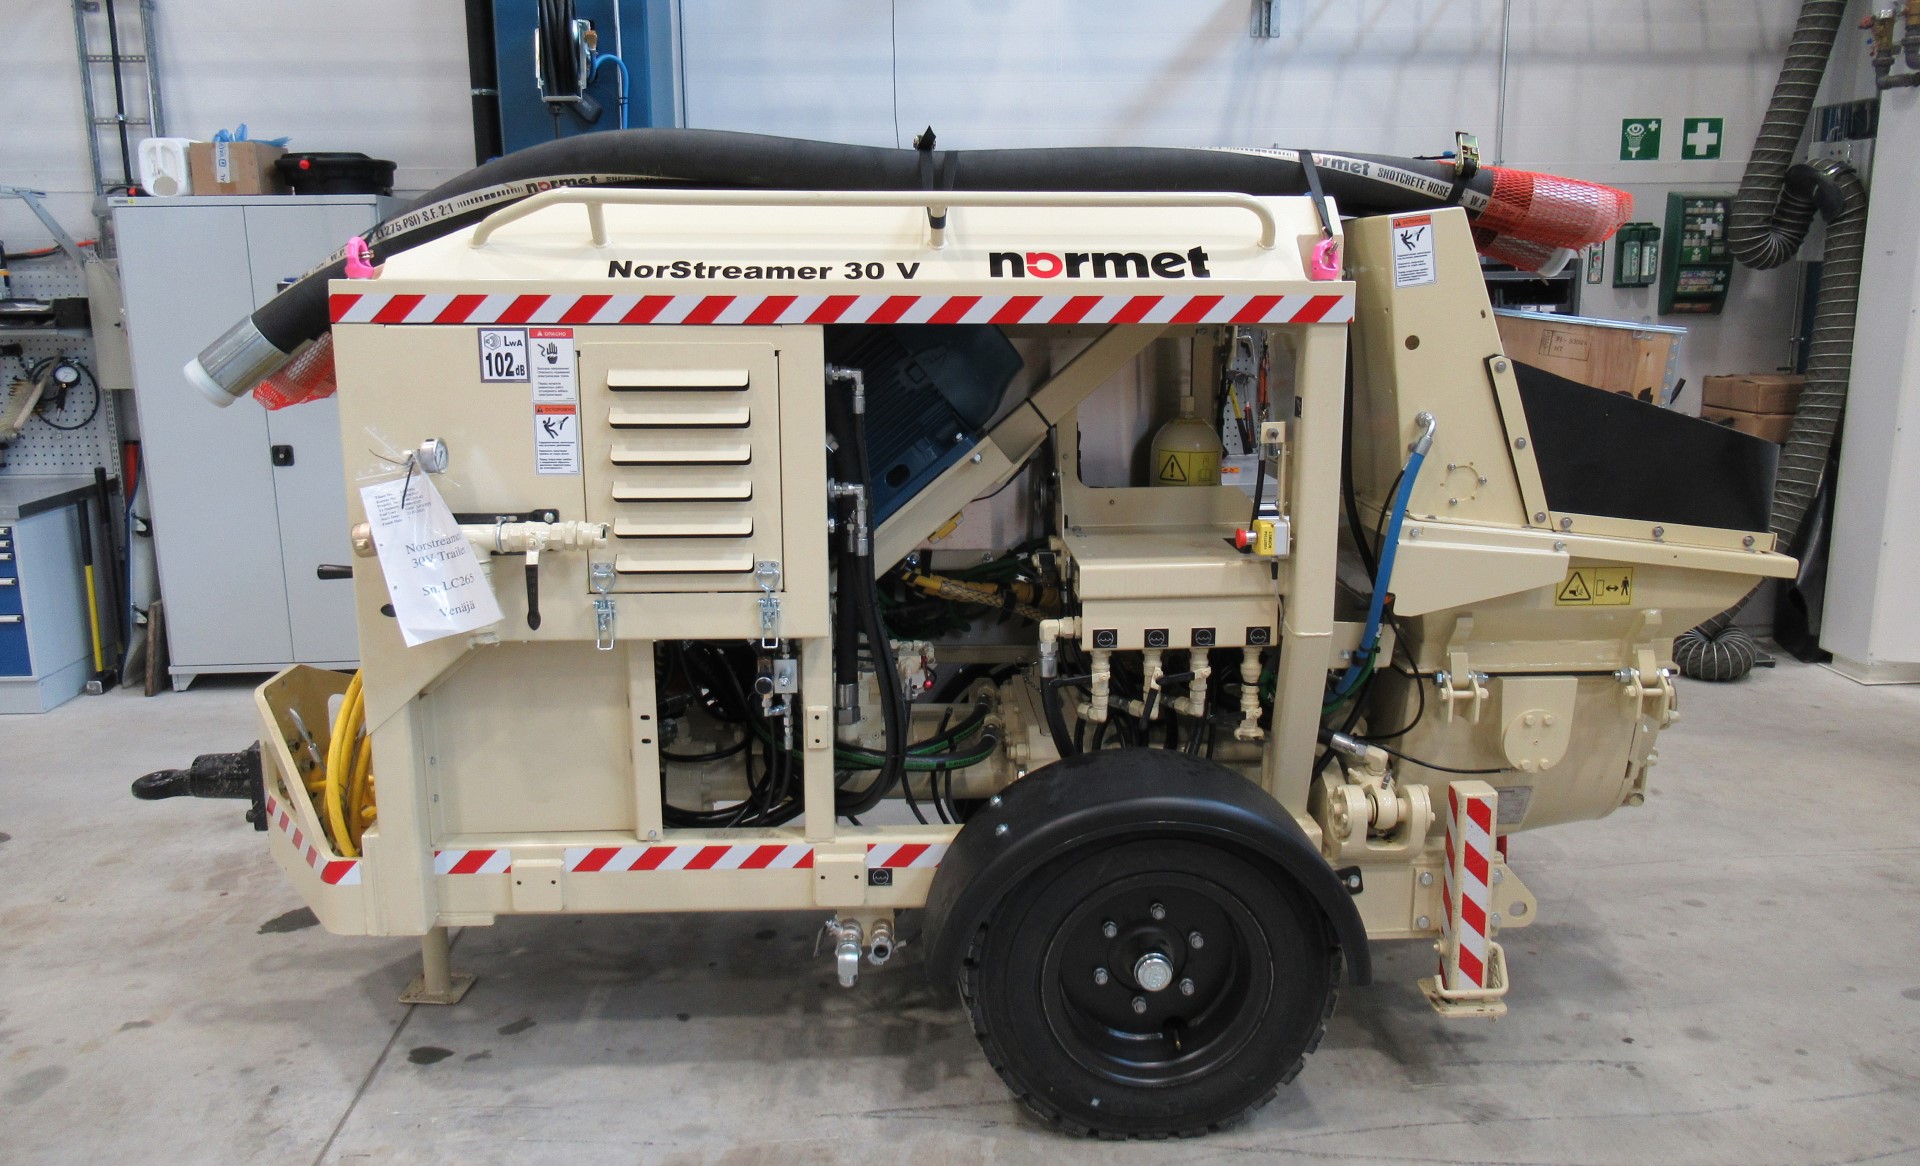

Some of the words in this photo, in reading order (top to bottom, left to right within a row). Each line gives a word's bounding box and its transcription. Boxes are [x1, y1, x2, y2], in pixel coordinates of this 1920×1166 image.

[1312, 156, 1370, 176] ormet
[526, 174, 597, 194] normet
[1377, 167, 1426, 190] SHOTCRETE
[1427, 181, 1450, 198] HOSE
[402, 213, 420, 229] PSI)
[422, 208, 439, 222] S.F.
[438, 202, 454, 217] 2:1
[608, 260, 833, 279] NorStreamer
[844, 262, 885, 280] 30
[896, 262, 921, 280] V
[989, 246, 1211, 279] normet
[443, 572, 475, 591] LC265
[439, 600, 476, 617] Venäjä
